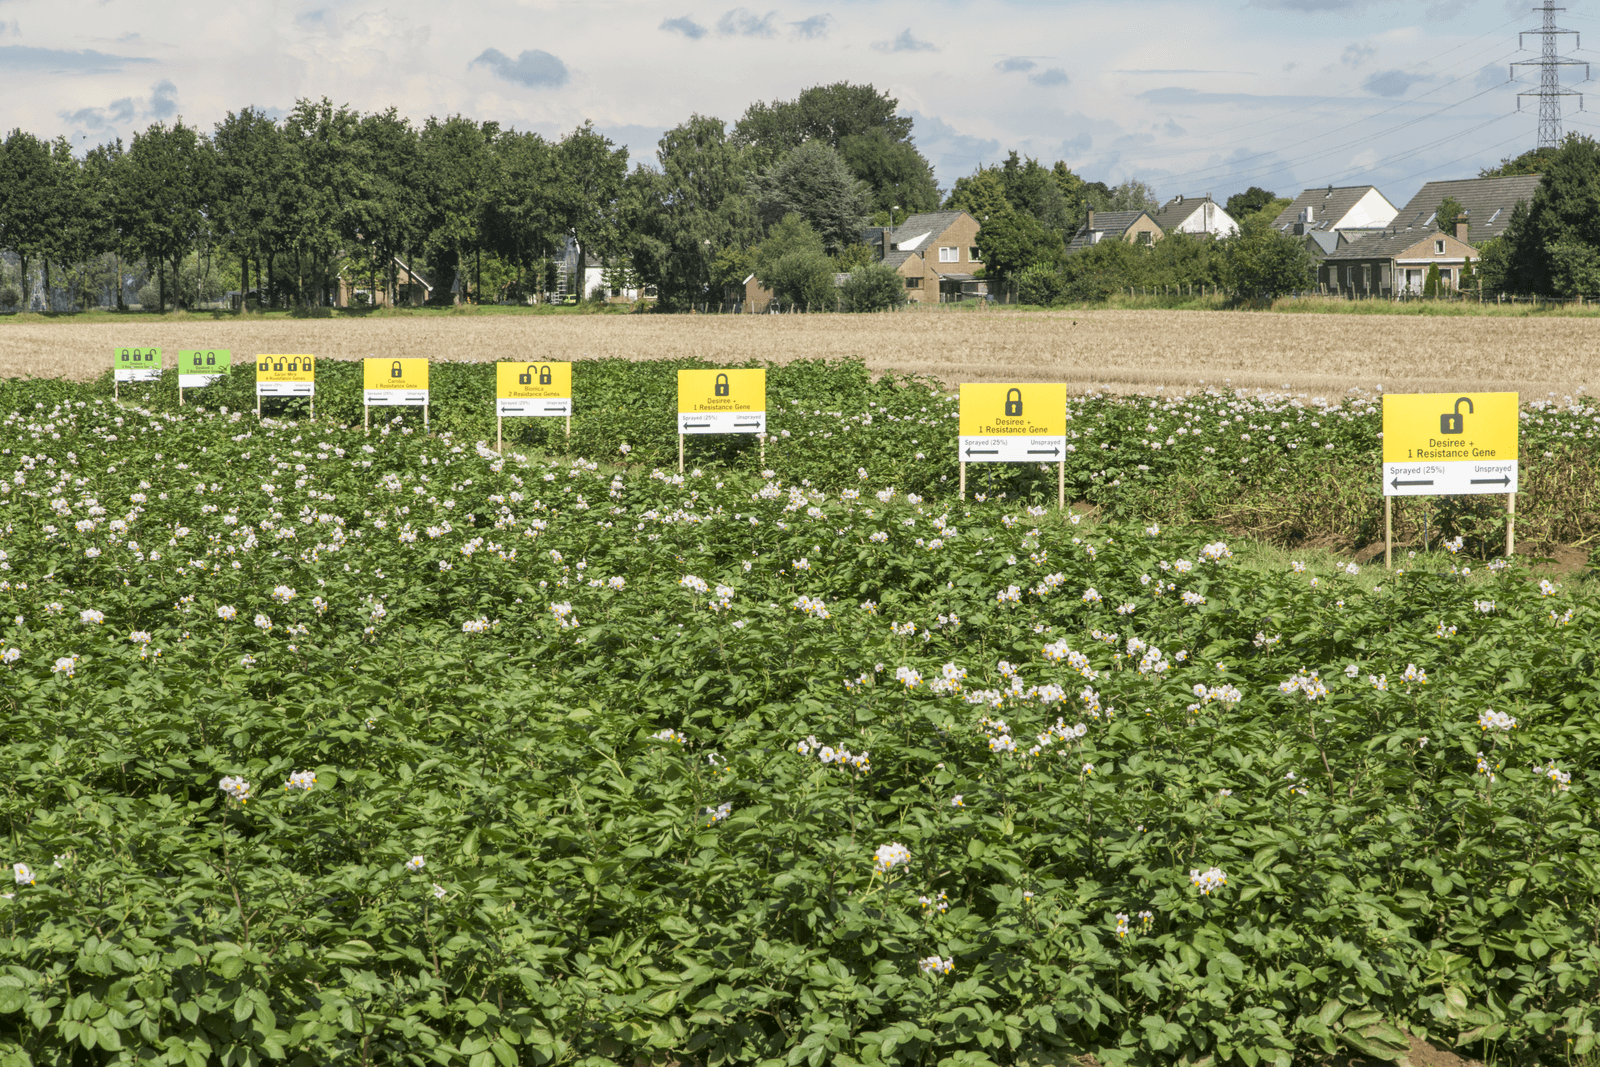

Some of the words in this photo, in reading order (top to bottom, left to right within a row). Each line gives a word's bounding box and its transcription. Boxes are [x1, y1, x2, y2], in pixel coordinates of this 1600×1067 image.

[1429, 438, 1466, 447] Desiree
[1408, 449, 1412, 458] 1
[1417, 449, 1469, 458] Resistance
[1472, 448, 1496, 457] Gene
[1390, 467, 1421, 475] Sprayed
[1423, 466, 1445, 474] (25%)
[1475, 465, 1512, 473] Unsprayed
